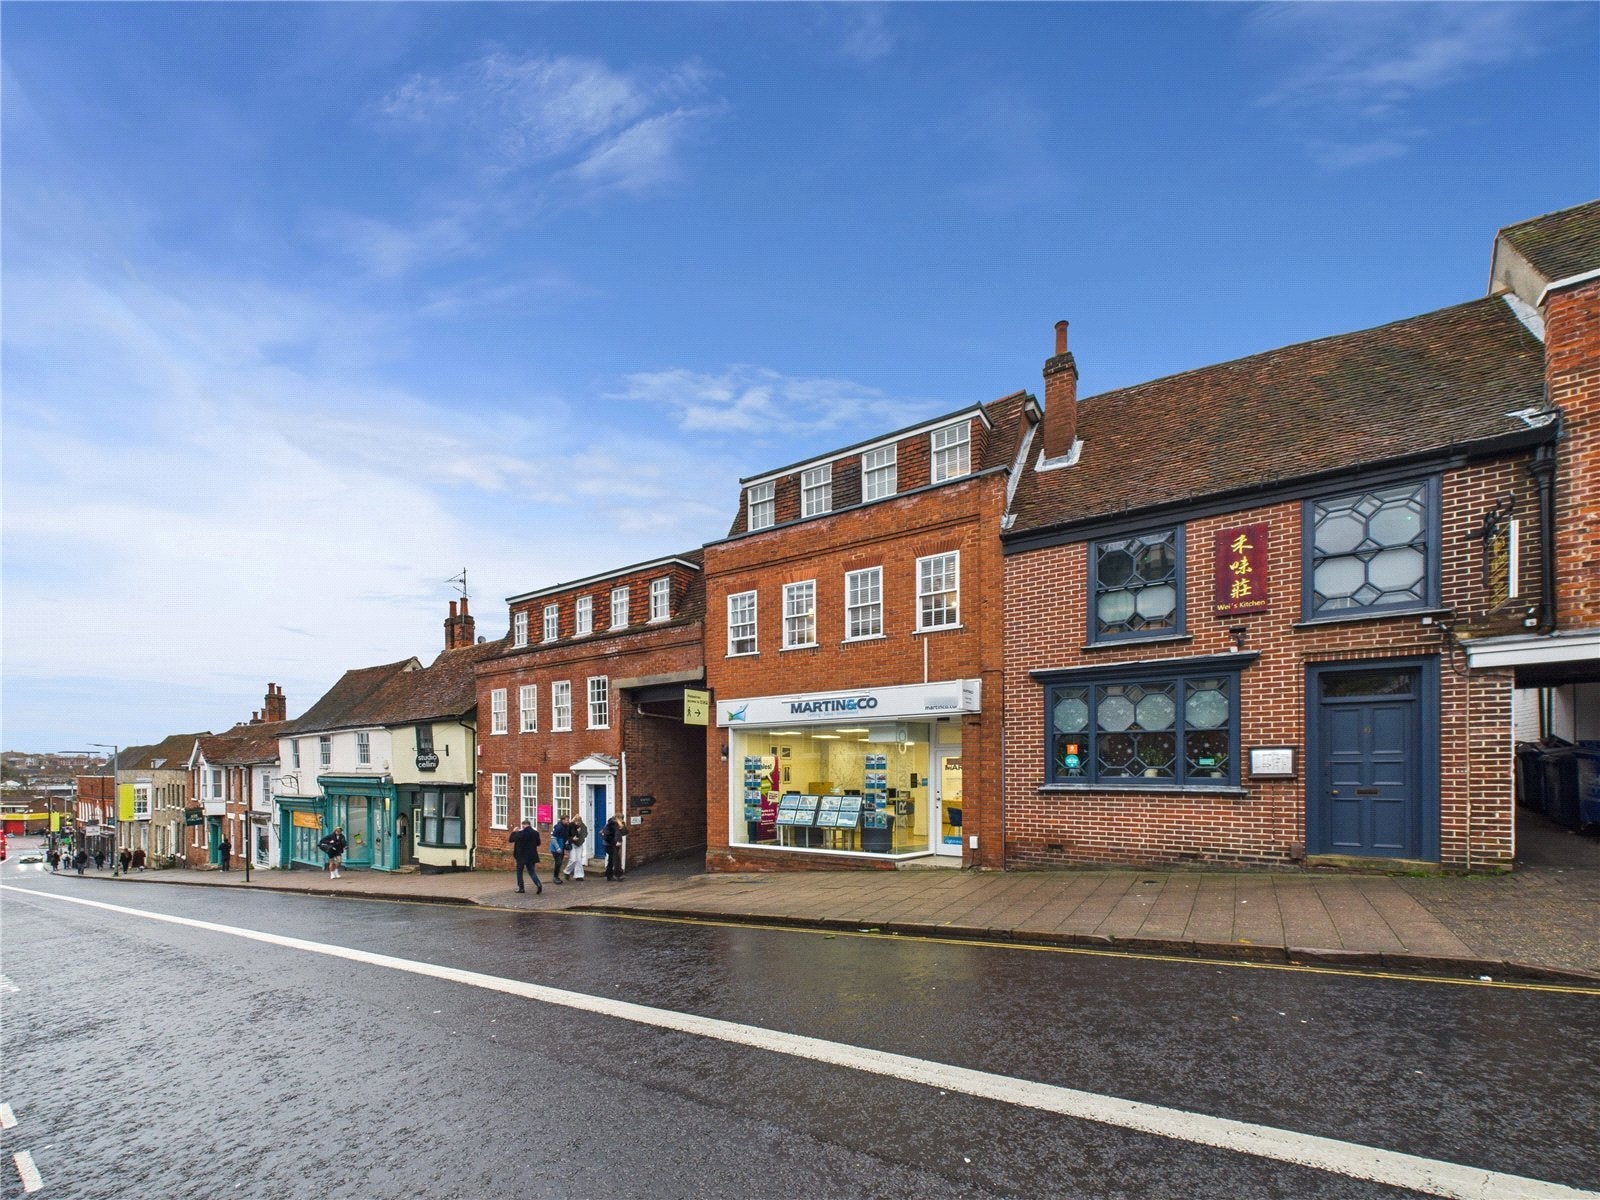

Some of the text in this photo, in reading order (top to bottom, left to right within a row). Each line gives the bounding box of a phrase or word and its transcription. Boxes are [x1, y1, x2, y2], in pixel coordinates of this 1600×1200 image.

[1239, 600, 1266, 608] Kitchen
[790, 697, 878, 714] MARTIN&CO
[418, 753, 437, 761] studio
